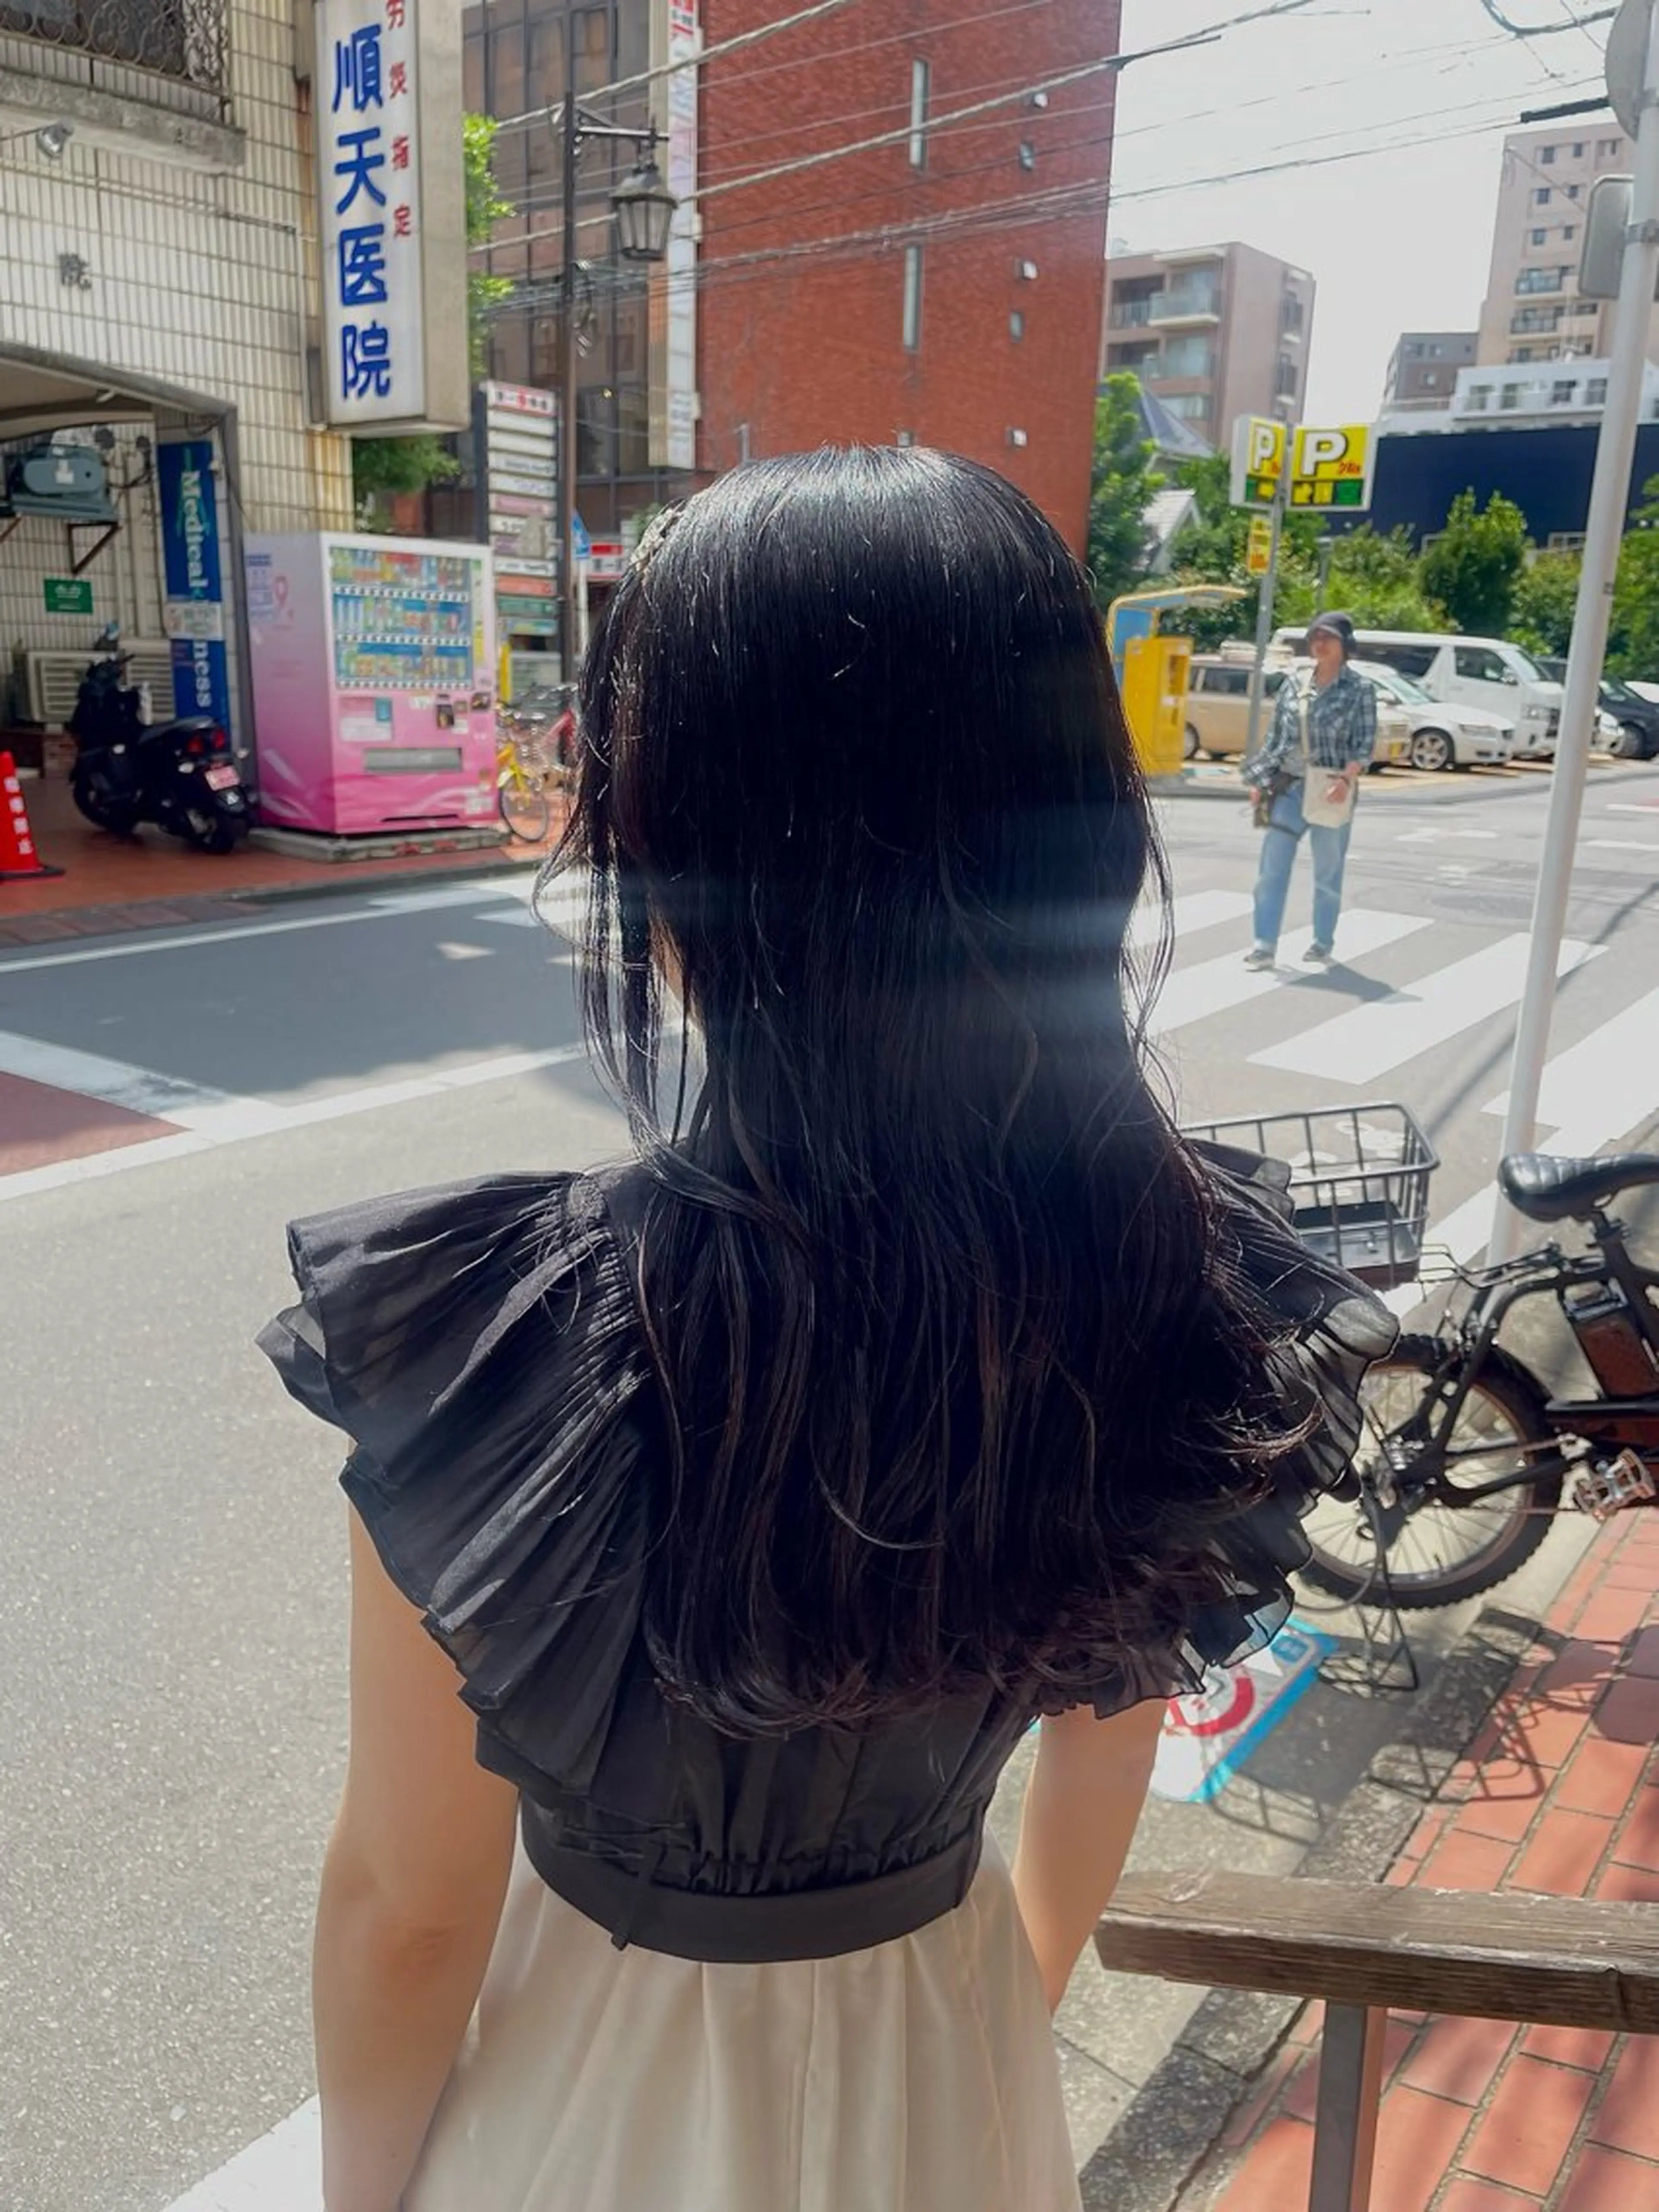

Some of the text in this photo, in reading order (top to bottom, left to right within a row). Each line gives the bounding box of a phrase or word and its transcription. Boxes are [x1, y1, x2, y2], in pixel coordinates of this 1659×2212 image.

[331, 23, 391, 398] 順天医院
[1253, 426, 1275, 472] P
[1301, 432, 1348, 475] P
[181, 470, 208, 587] Medical
